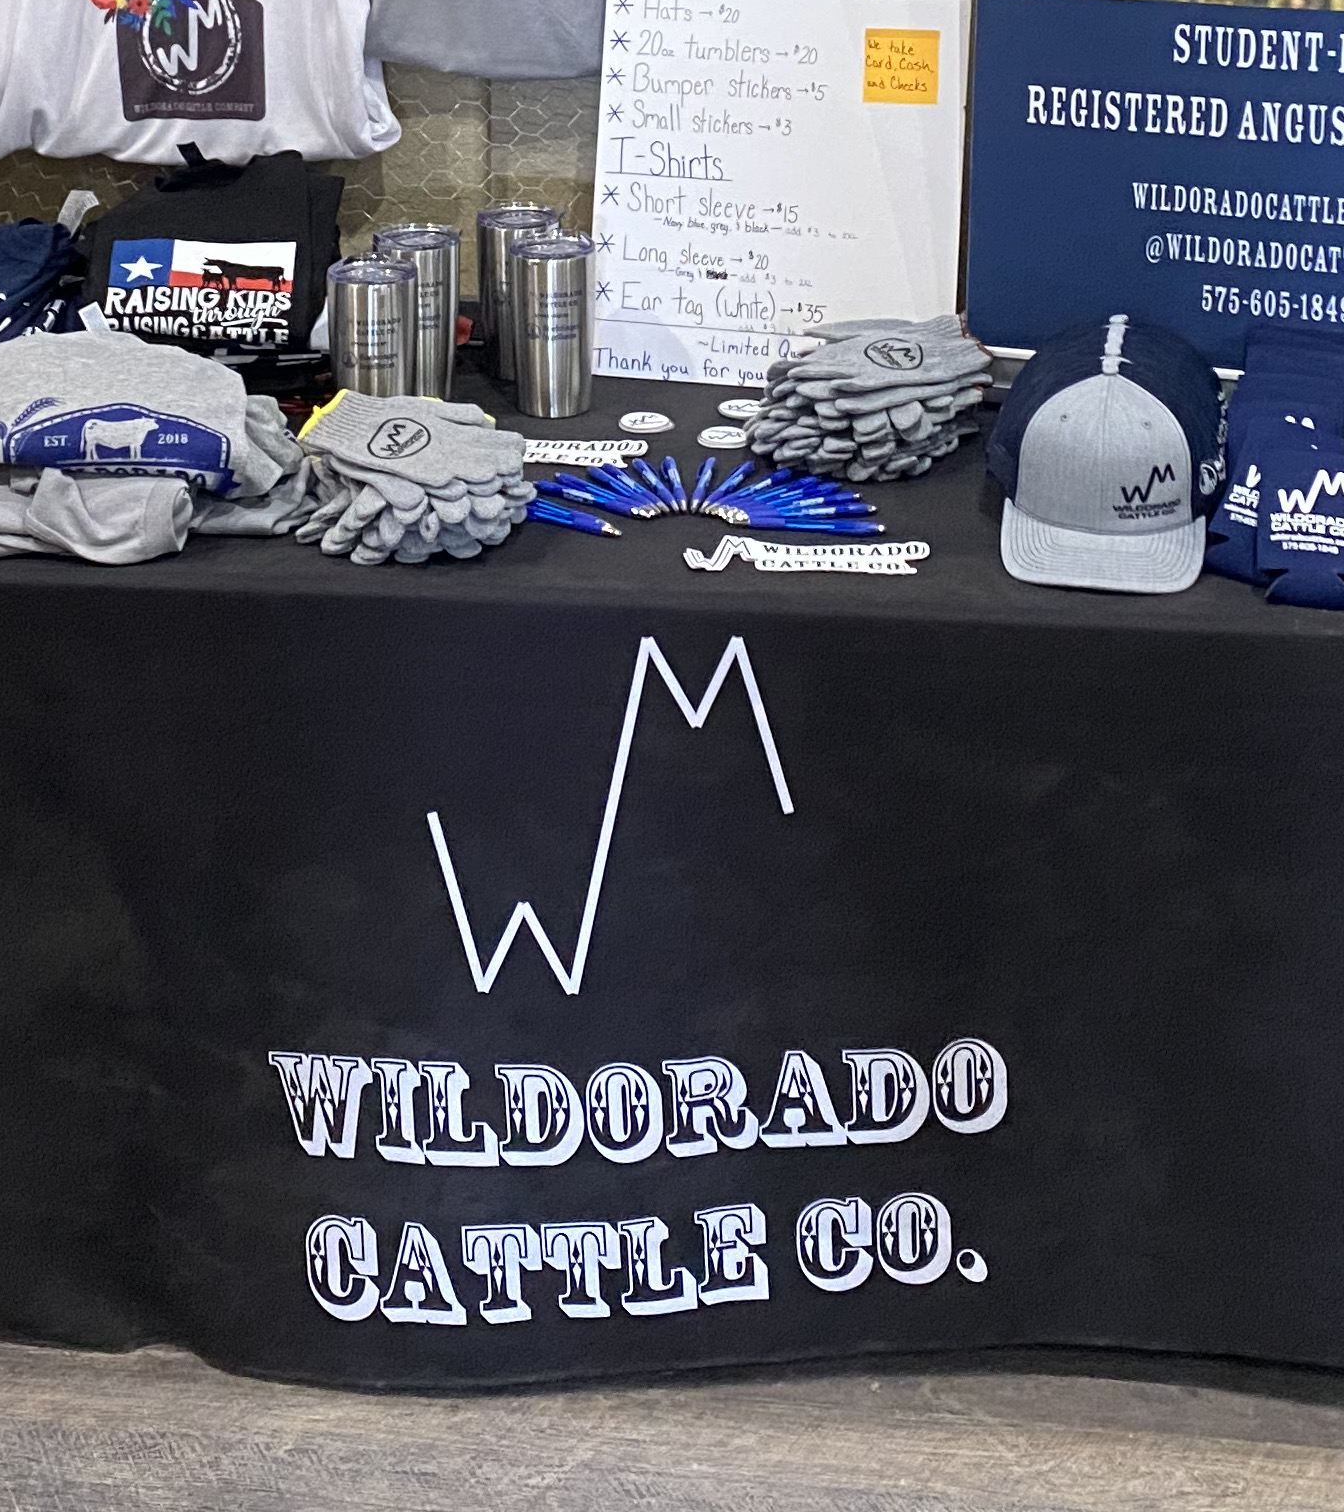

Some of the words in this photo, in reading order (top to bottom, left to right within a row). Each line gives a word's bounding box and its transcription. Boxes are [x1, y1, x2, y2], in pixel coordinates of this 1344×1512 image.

[719, 4, 740, 24] $20
[636, 29, 675, 57] 20oz
[684, 34, 770, 63] tumblers
[794, 44, 818, 65] $20
[889, 40, 915, 56] take
[632, 62, 714, 108] Bumper
[728, 69, 792, 101] stickers
[811, 82, 829, 101] $5
[891, 76, 927, 92] Checks
[632, 99, 681, 131] Small
[692, 108, 753, 135] stickers
[775, 118, 792, 136] $3
[1026, 84, 1229, 139] REGISTERED
[610, 136, 725, 181] T-Shirts
[627, 182, 686, 214] Short
[698, 188, 756, 219] sleeve
[776, 202, 799, 223] $15
[622, 235, 667, 273] Long
[680, 242, 724, 267] sleeve
[748, 249, 769, 271] $20
[104, 286, 220, 316] RAISING
[227, 290, 292, 311] KIDS
[190, 303, 292, 329] through
[621, 280, 662, 311] Ear
[671, 286, 703, 325] tag
[797, 302, 827, 324] $35
[593, 347, 653, 373] Thank
[660, 361, 690, 380] you
[703, 360, 729, 378] for
[738, 368, 765, 388] you
[43, 435, 71, 447] EST.
[157, 433, 189, 445] 2018
[527, 441, 630, 452] DORADO
[1271, 522, 1326, 534] CATTLE
[762, 543, 919, 556] WILDORADO
[762, 560, 859, 570] CATTLE
[269, 1038, 1008, 1168] WILDORADO
[305, 1203, 770, 1326] CATTLE
[795, 1191, 989, 1292] CO.
